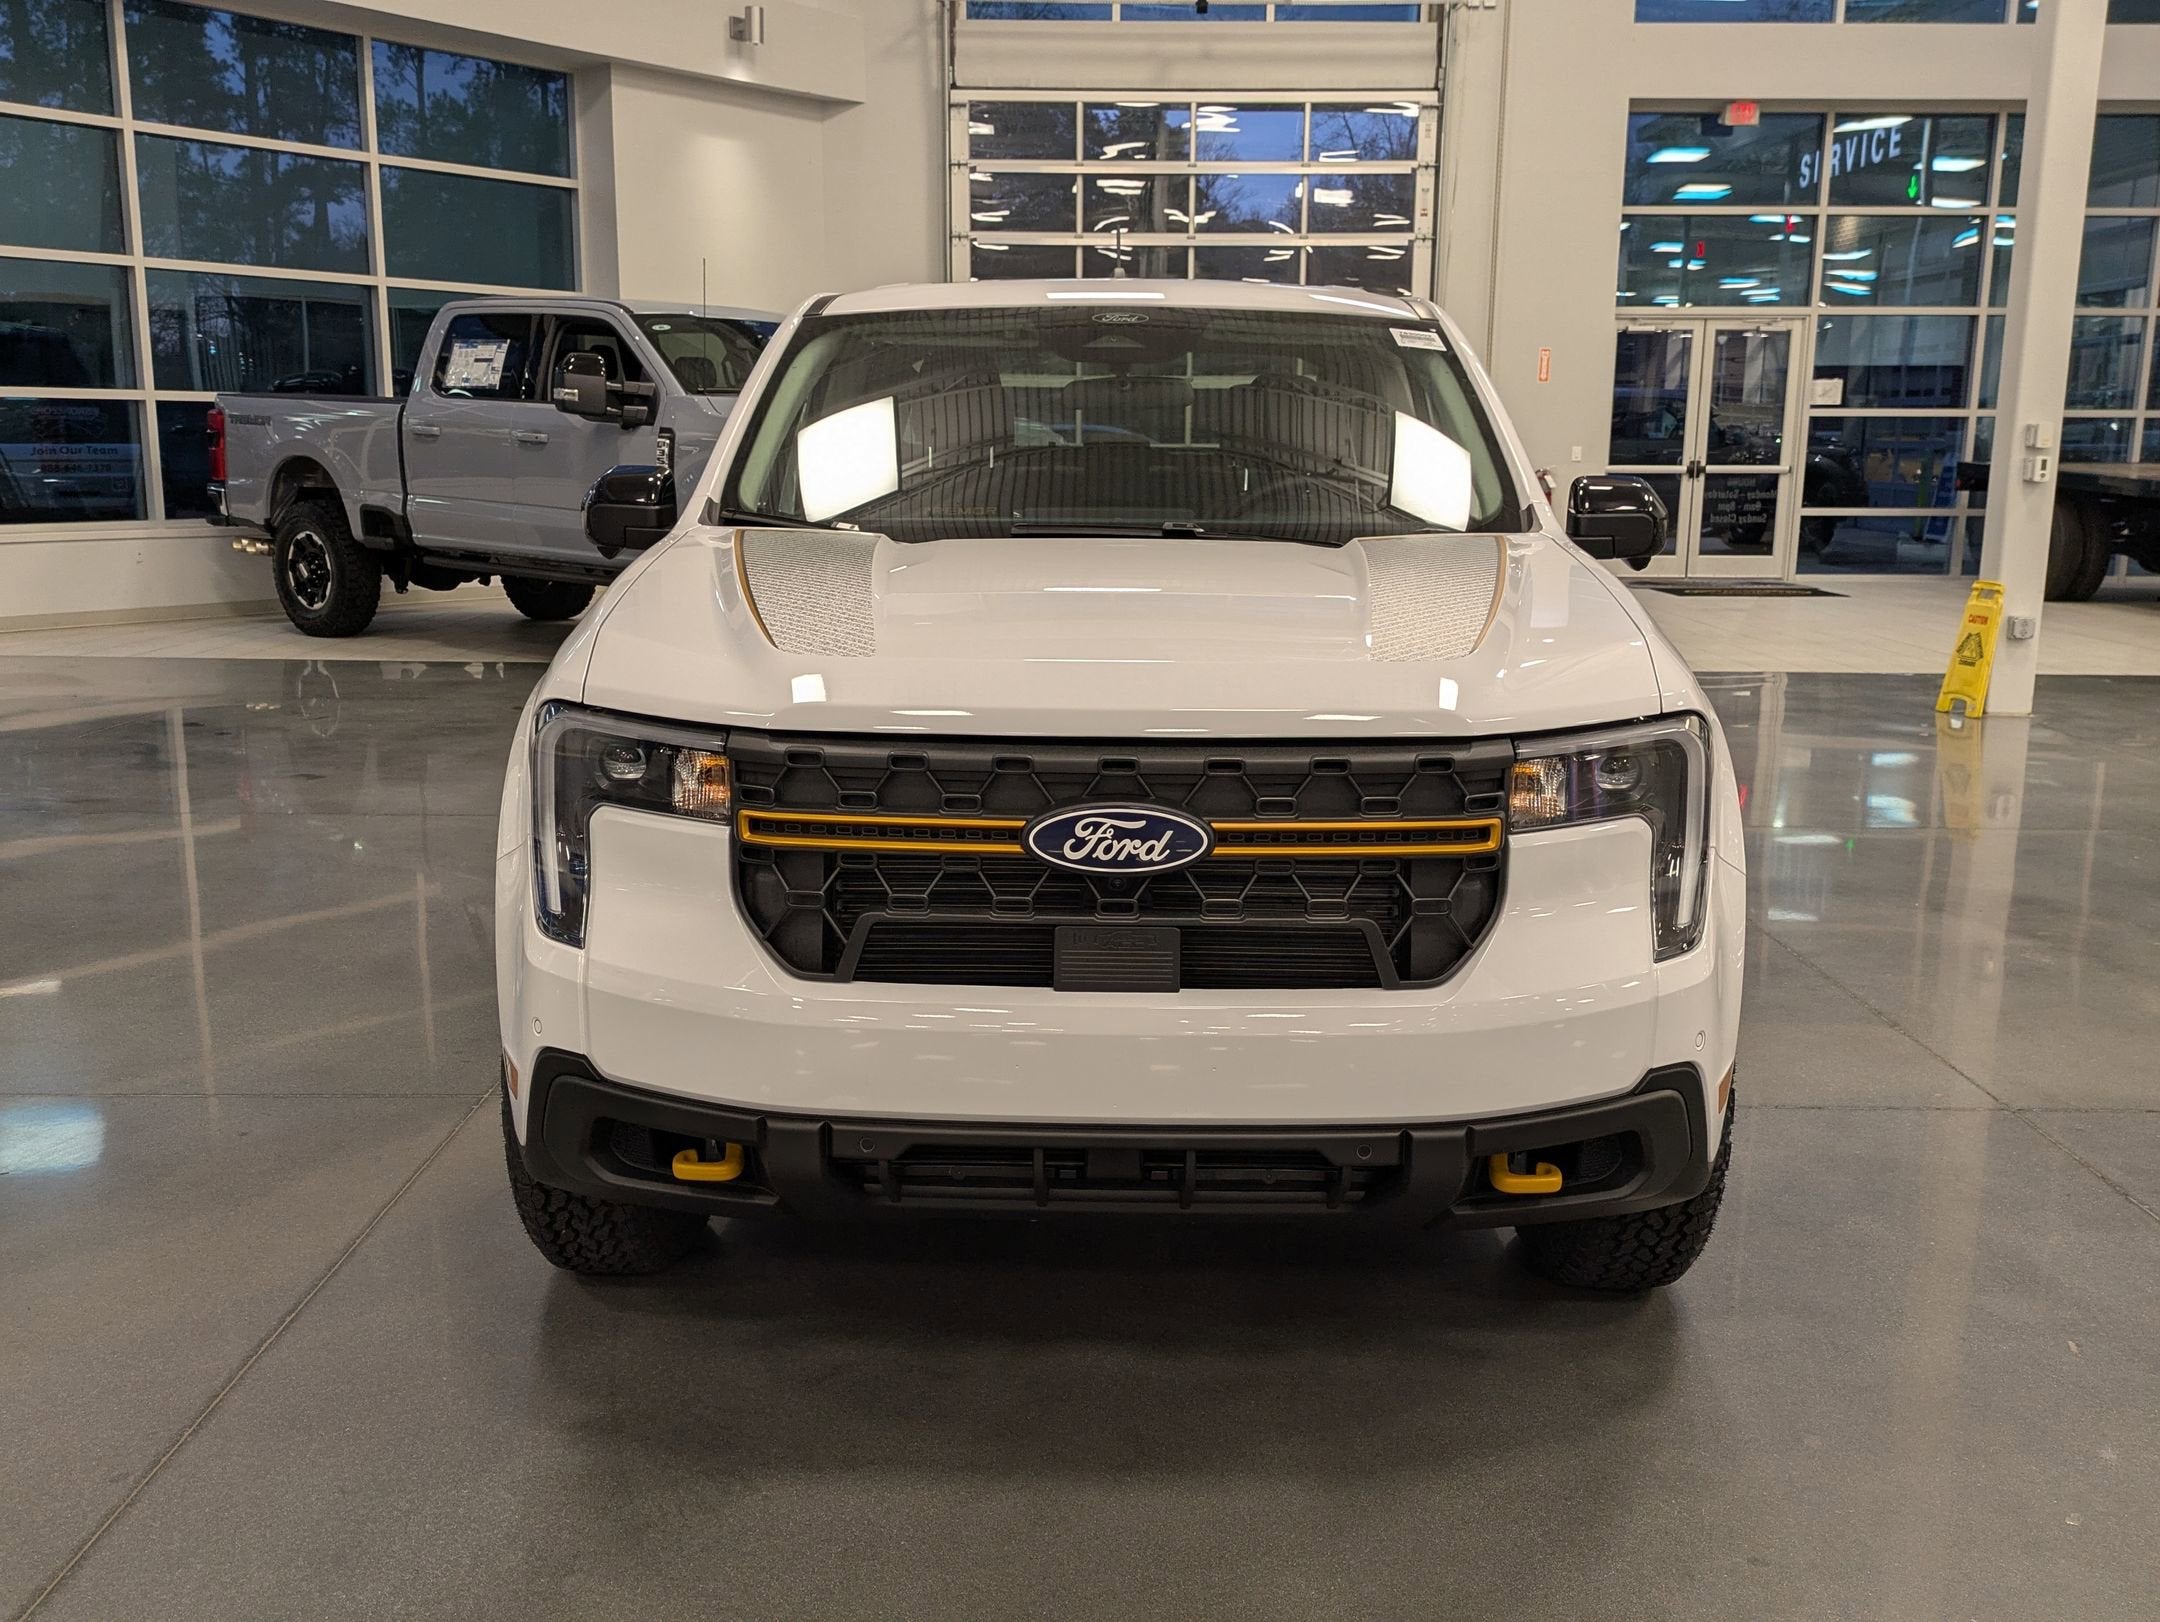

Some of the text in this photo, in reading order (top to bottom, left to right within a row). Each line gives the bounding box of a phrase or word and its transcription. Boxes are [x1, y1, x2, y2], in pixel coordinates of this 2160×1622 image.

[1102, 313, 1139, 322] Ford
[229, 414, 271, 426] TREMOR
[31, 446, 118, 456] Join Our Team
[1063, 816, 1174, 862] Ford
